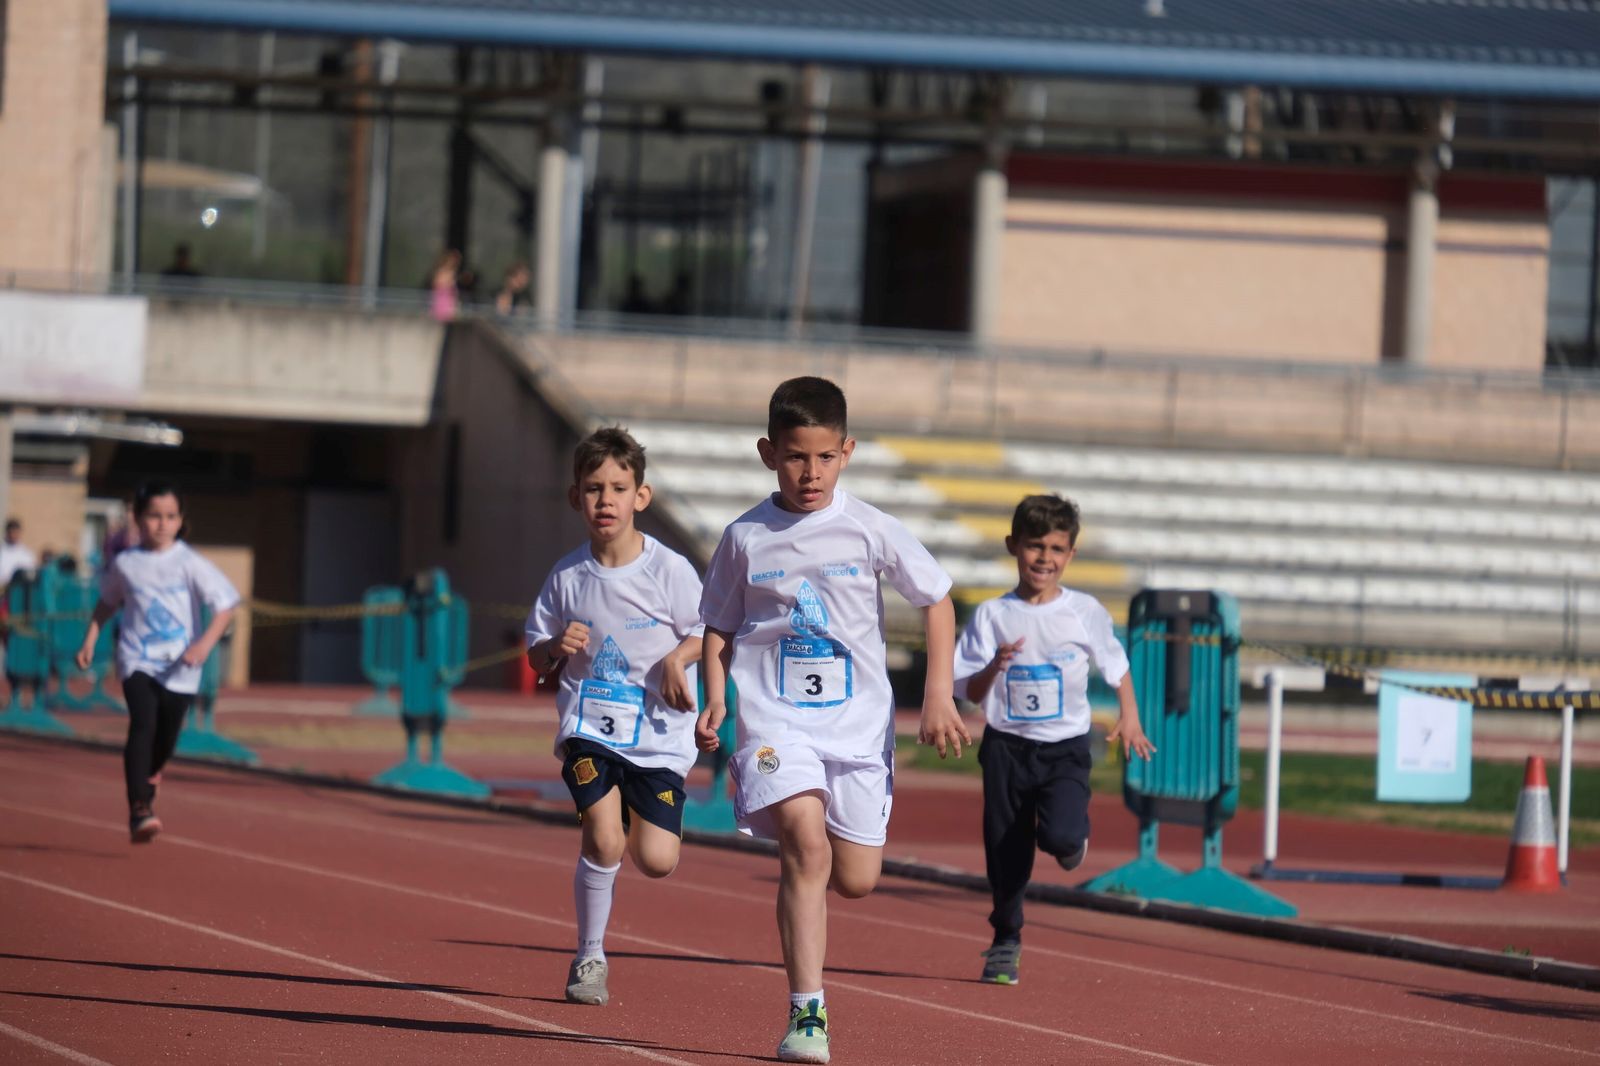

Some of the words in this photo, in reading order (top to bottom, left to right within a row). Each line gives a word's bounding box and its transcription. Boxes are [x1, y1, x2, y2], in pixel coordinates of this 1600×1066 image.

[752, 570, 777, 580] EMACSA
[823, 567, 849, 576] unicef
[597, 656, 627, 670] GOTA
[805, 674, 823, 695] 3
[1026, 694, 1040, 711] 3
[600, 716, 615, 735] 3
